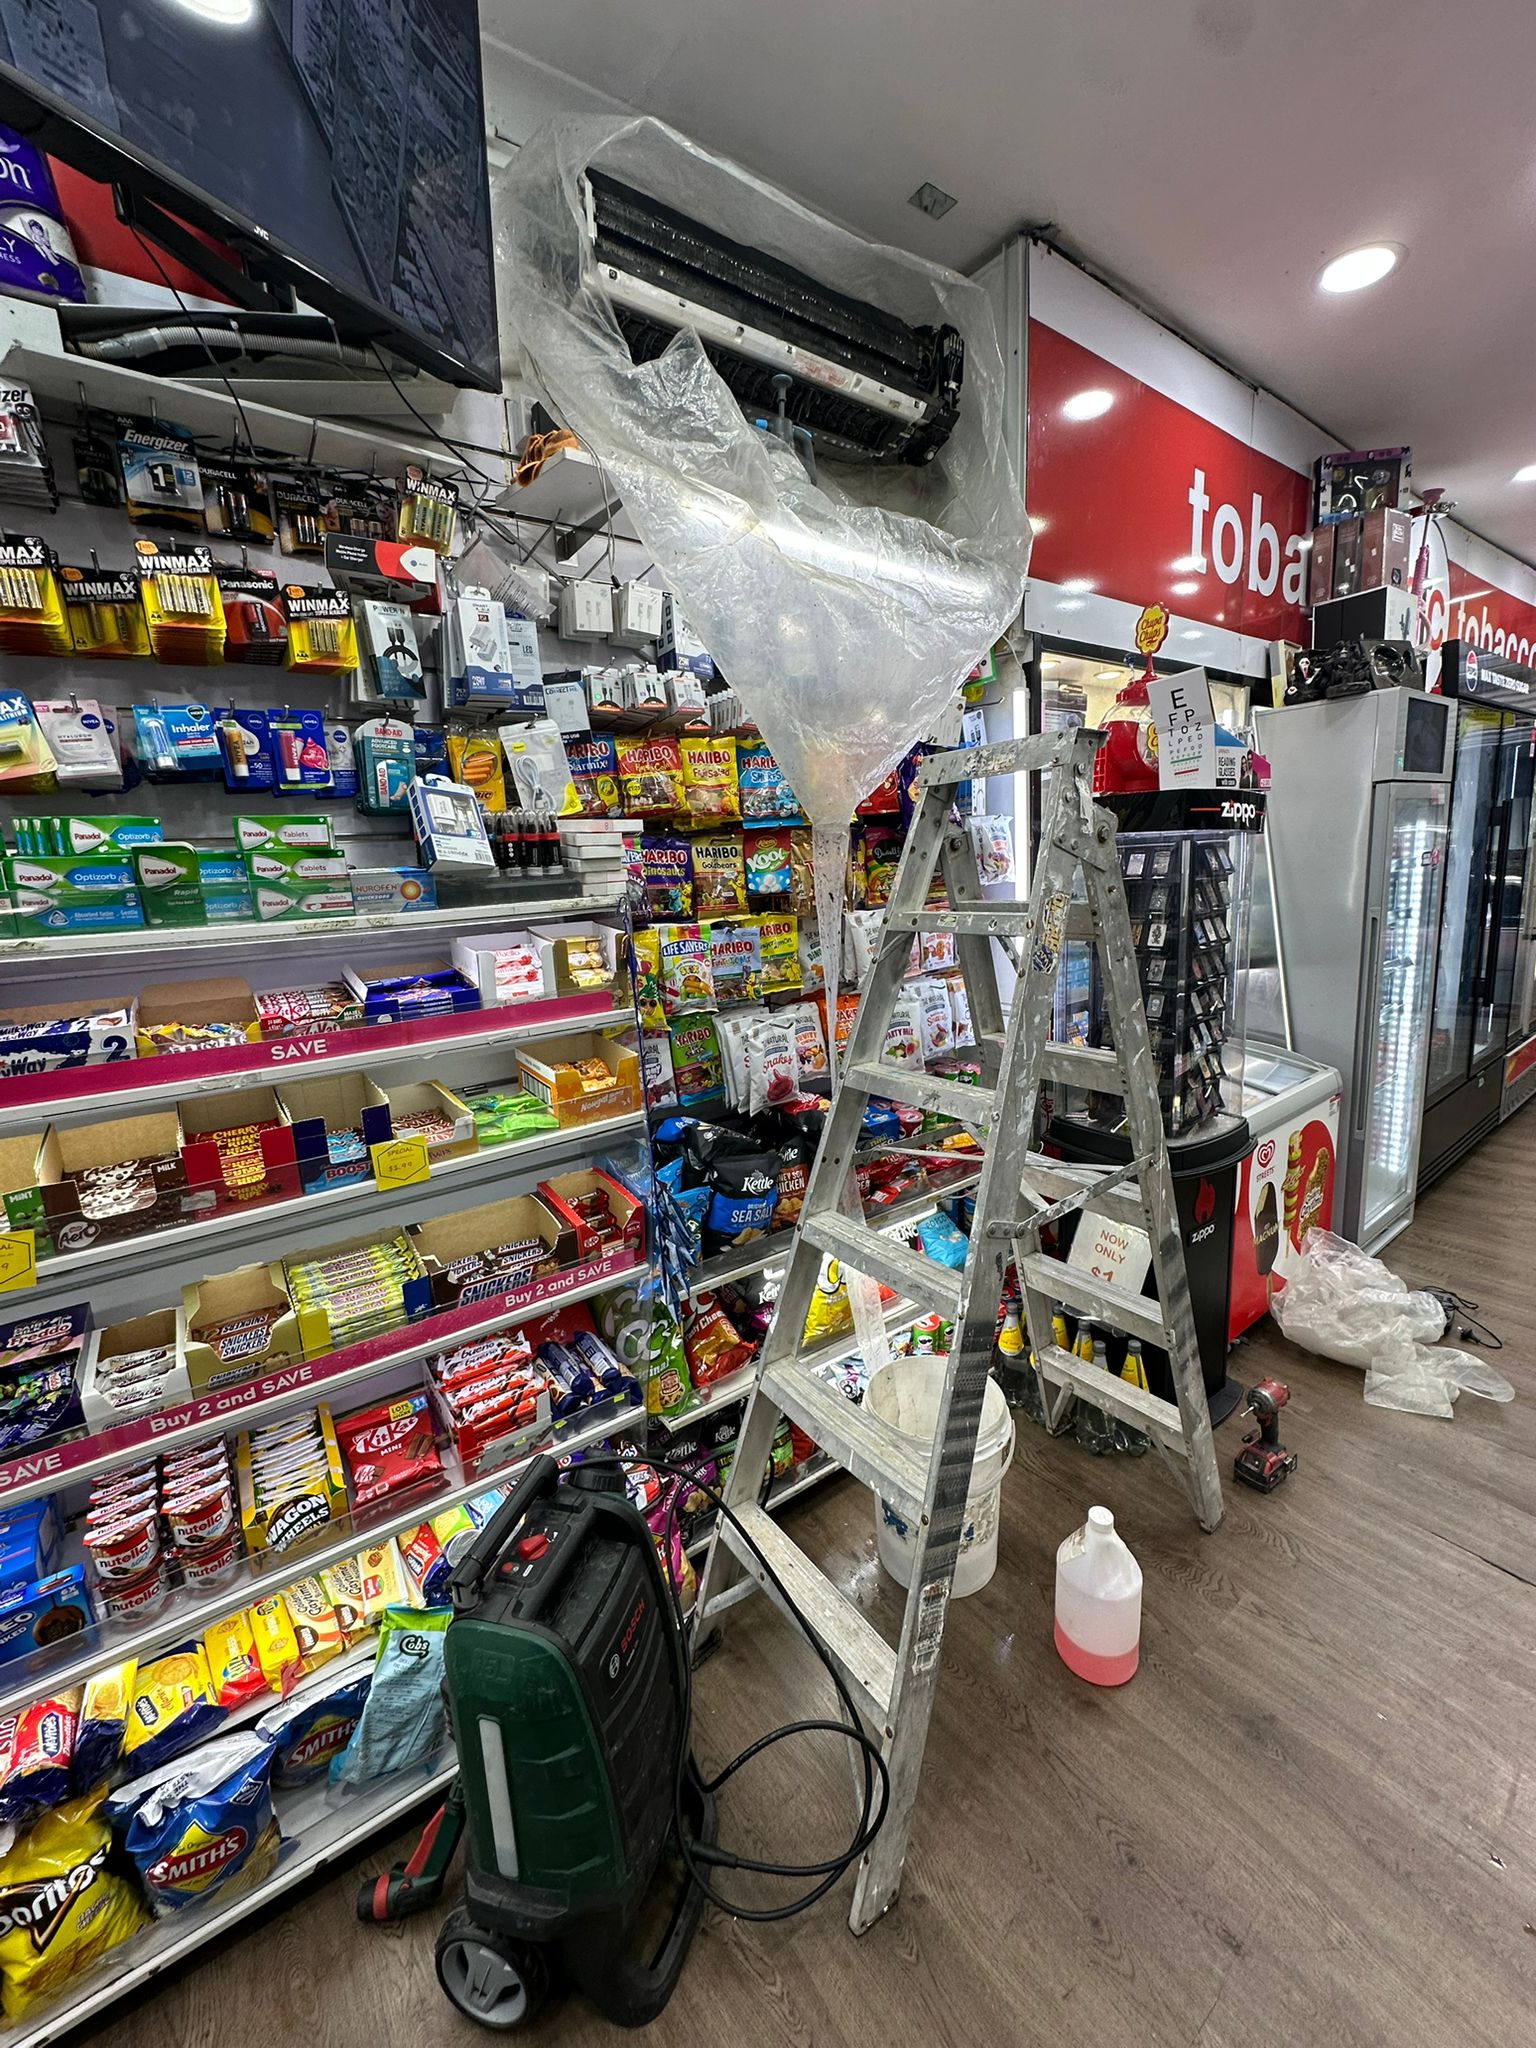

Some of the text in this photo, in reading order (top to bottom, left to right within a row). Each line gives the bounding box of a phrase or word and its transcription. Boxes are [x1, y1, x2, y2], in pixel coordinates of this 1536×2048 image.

[253, 225, 269, 240] JVC
[124, 428, 189, 452] Energizer
[406, 478, 457, 501] WINMAX
[138, 555, 212, 570] WINMAX
[63, 581, 137, 596] WINMAX
[219, 579, 275, 590] Panasonic
[288, 599, 350, 613] WINMAX
[1141, 617, 1163, 633] Chupa
[1139, 627, 1162, 644] Chups
[1171, 688, 1187, 710] E
[1168, 709, 1194, 726] F P
[171, 723, 210, 733] Inhaler
[1168, 722, 1202, 737] T O Z
[626, 746, 672, 762] HARIBO
[1218, 757, 1236, 767] READING
[1218, 767, 1236, 777] GLASSES
[75, 832, 151, 842] Panadol Optizorb
[243, 831, 268, 839] Panadol
[641, 850, 687, 865] HARIBO
[695, 847, 738, 859] HARIBO
[144, 867, 177, 876] Panadol
[256, 865, 283, 874] Panadol
[702, 862, 737, 870] Goldbears
[19, 872, 117, 883] Panadol Optizorb
[174, 888, 198, 897] Rapid
[355, 884, 397, 893] NUROFEN
[262, 899, 289, 908] Panadol
[663, 940, 710, 957] LIFE SAVERS
[711, 941, 754, 957] HARIBO
[77, 1020, 88, 1031] 2
[102, 1036, 128, 1063] 2
[271, 1039, 327, 1060] SAVE
[212, 1125, 259, 1140] CHERRY
[387, 1146, 414, 1158] SPECIAL
[157, 1162, 176, 1173] MILK
[326, 1163, 371, 1181] BOOST
[228, 1181, 269, 1197] CHERRY
[741, 1175, 774, 1196] Kettle
[9, 1189, 33, 1204] MINT
[237, 1189, 261, 1201] RIPE
[731, 1209, 752, 1224] SEA
[58, 1225, 97, 1251] Aero
[498, 1237, 540, 1253] SNICKERS
[1099, 1230, 1130, 1250] NOW
[501, 1248, 543, 1265] SNICKERS
[1094, 1244, 1126, 1265] ONLY
[504, 1260, 612, 1308] Buy 2 and SAVE
[221, 1327, 265, 1349] SNICKERS
[224, 1337, 268, 1357] SNICKERS
[461, 1341, 494, 1359] bueno
[150, 1410, 192, 1434] Buy
[198, 1402, 212, 1418] 2
[215, 1385, 258, 1410] and
[262, 1366, 313, 1396] SAVE
[361, 1417, 418, 1453] KitKat
[381, 1443, 402, 1456] MINI
[0, 1453, 62, 1487] SAVE
[176, 1471, 205, 1486] nutella
[102, 1480, 134, 1496] nutella
[176, 1489, 206, 1505] nutella
[100, 1499, 132, 1514] nutella
[178, 1512, 223, 1536] nutella
[265, 1493, 327, 1544] WAGON
[98, 1519, 131, 1535] nutella
[274, 1507, 330, 1553] WHEELS
[100, 1543, 148, 1569] nutella
[189, 1553, 233, 1578] nutella
[333, 1572, 348, 1594] Golden
[340, 1563, 362, 1595] Gaytime
[112, 1584, 160, 1612] nutella
[291, 1591, 308, 1615] Golden
[299, 1582, 322, 1617] Gaytime
[621, 1598, 645, 1654] BOSCH
[402, 1635, 430, 1657] Cobs
[152, 1835, 240, 1884] SMITH'S
